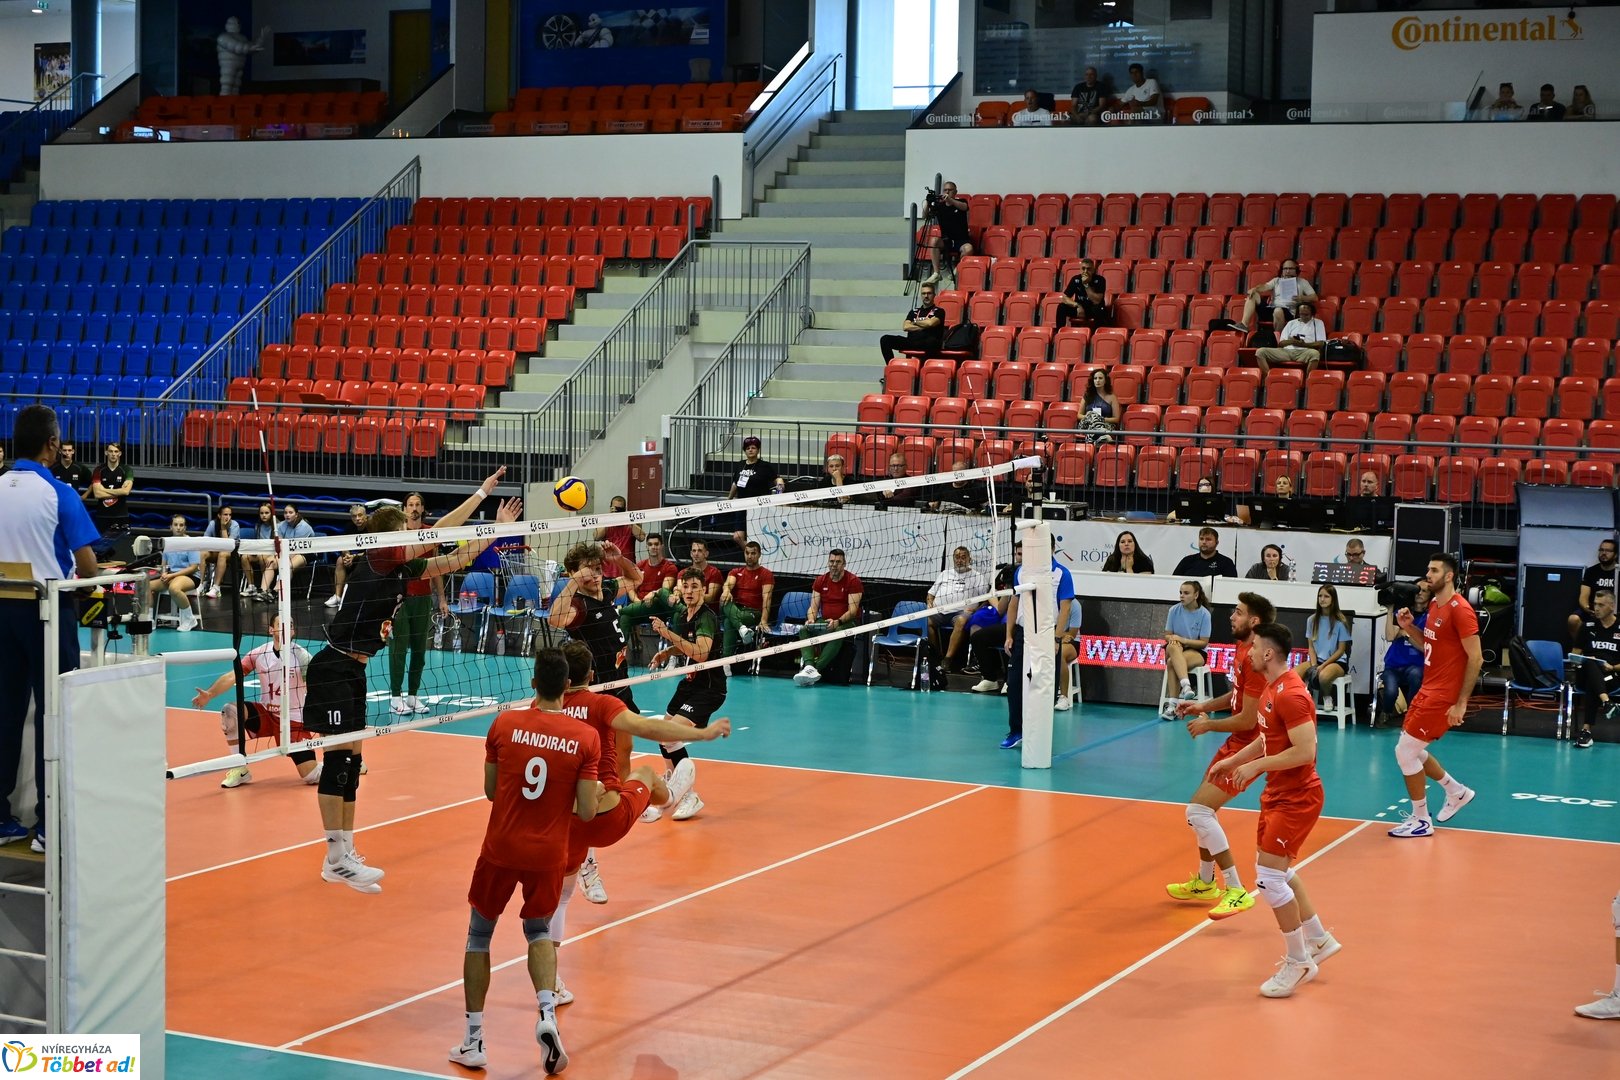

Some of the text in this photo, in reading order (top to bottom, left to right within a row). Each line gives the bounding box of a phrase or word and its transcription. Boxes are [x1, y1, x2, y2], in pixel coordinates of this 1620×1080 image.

[1391, 15, 1557, 50] Continental
[926, 112, 975, 125] Continental
[1012, 112, 1062, 124] Continental
[1101, 110, 1152, 123] Continental
[1193, 110, 1245, 122] Continental
[426, 531, 438, 539] CEV
[484, 526, 496, 534] CEV
[298, 541, 312, 549] CEV
[365, 536, 378, 544] CEV
[612, 619, 625, 643] 5
[1592, 640, 1618, 652] VESTEL
[327, 710, 342, 725] 10
[512, 728, 578, 754] MANDIRACI
[522, 756, 548, 800] 9
